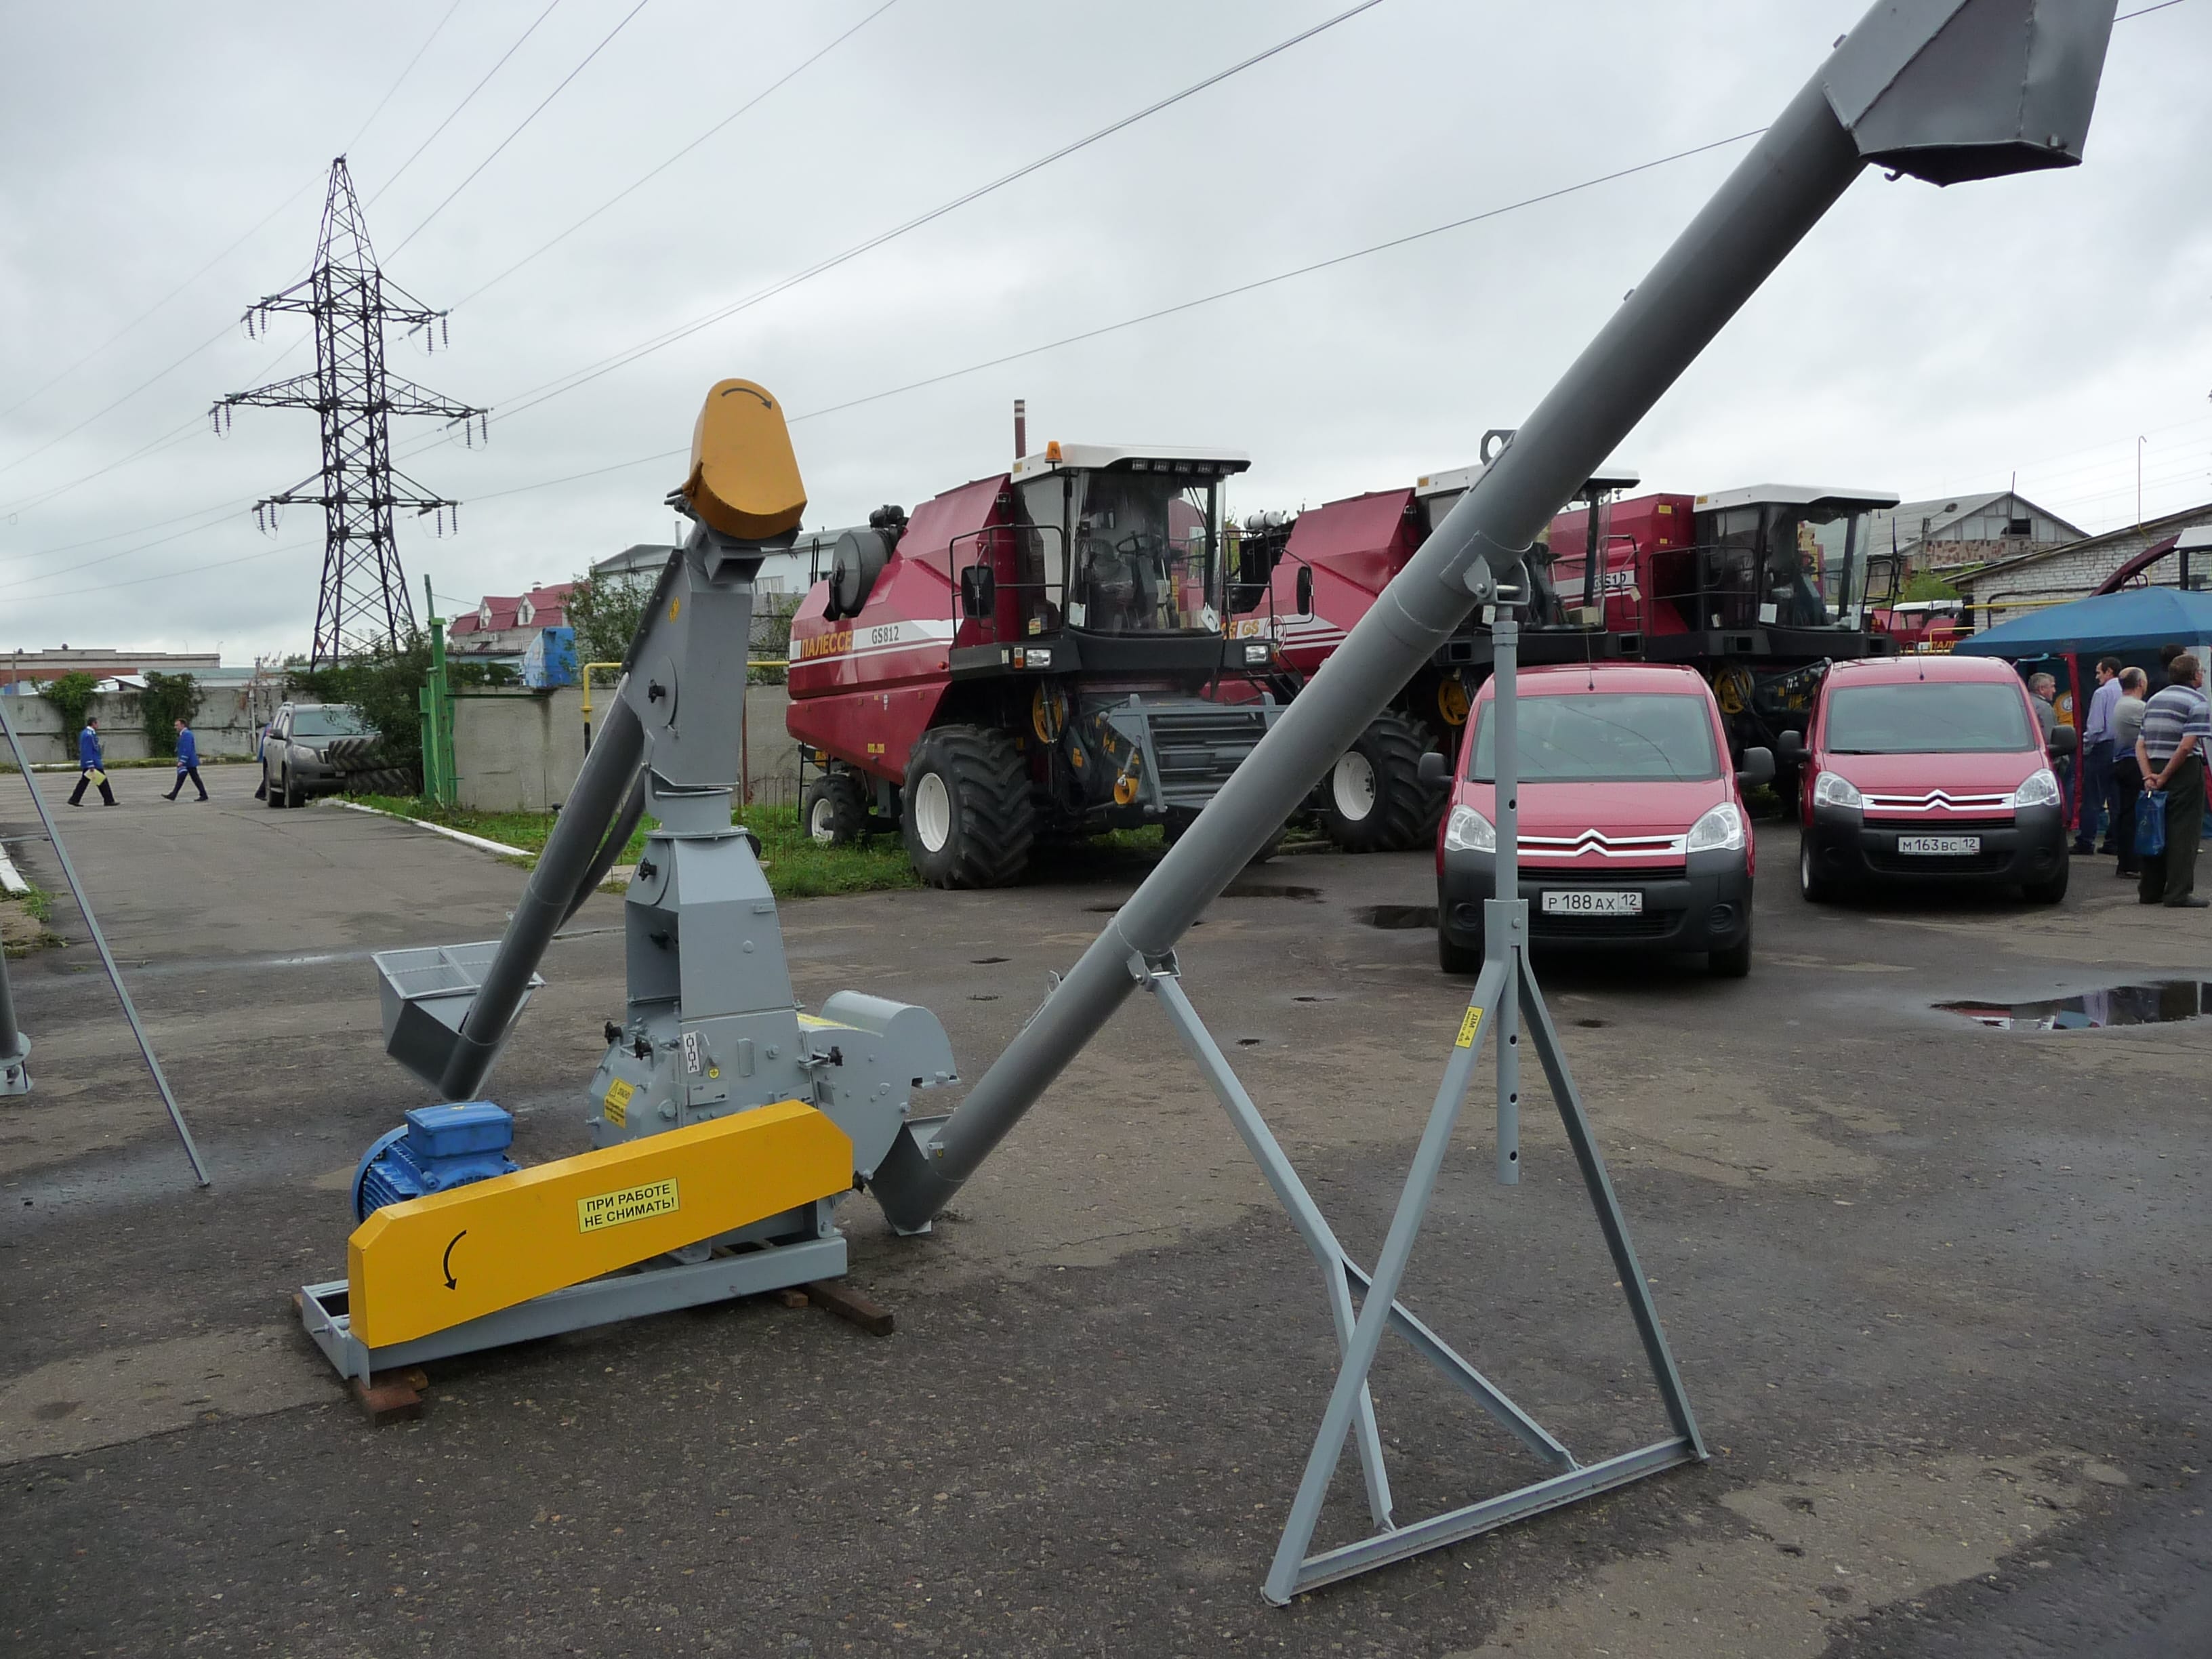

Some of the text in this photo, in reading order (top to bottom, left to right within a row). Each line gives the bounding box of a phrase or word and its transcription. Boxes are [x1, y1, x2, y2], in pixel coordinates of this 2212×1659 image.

[801, 626, 899, 658] ПАЛЕССЕ GS812
[1621, 894, 1637, 906] 12
[585, 1197, 674, 1227] НЕ СНИМАТЬ!
[587, 1183, 670, 1212] ПРИ РАБОТЕ
